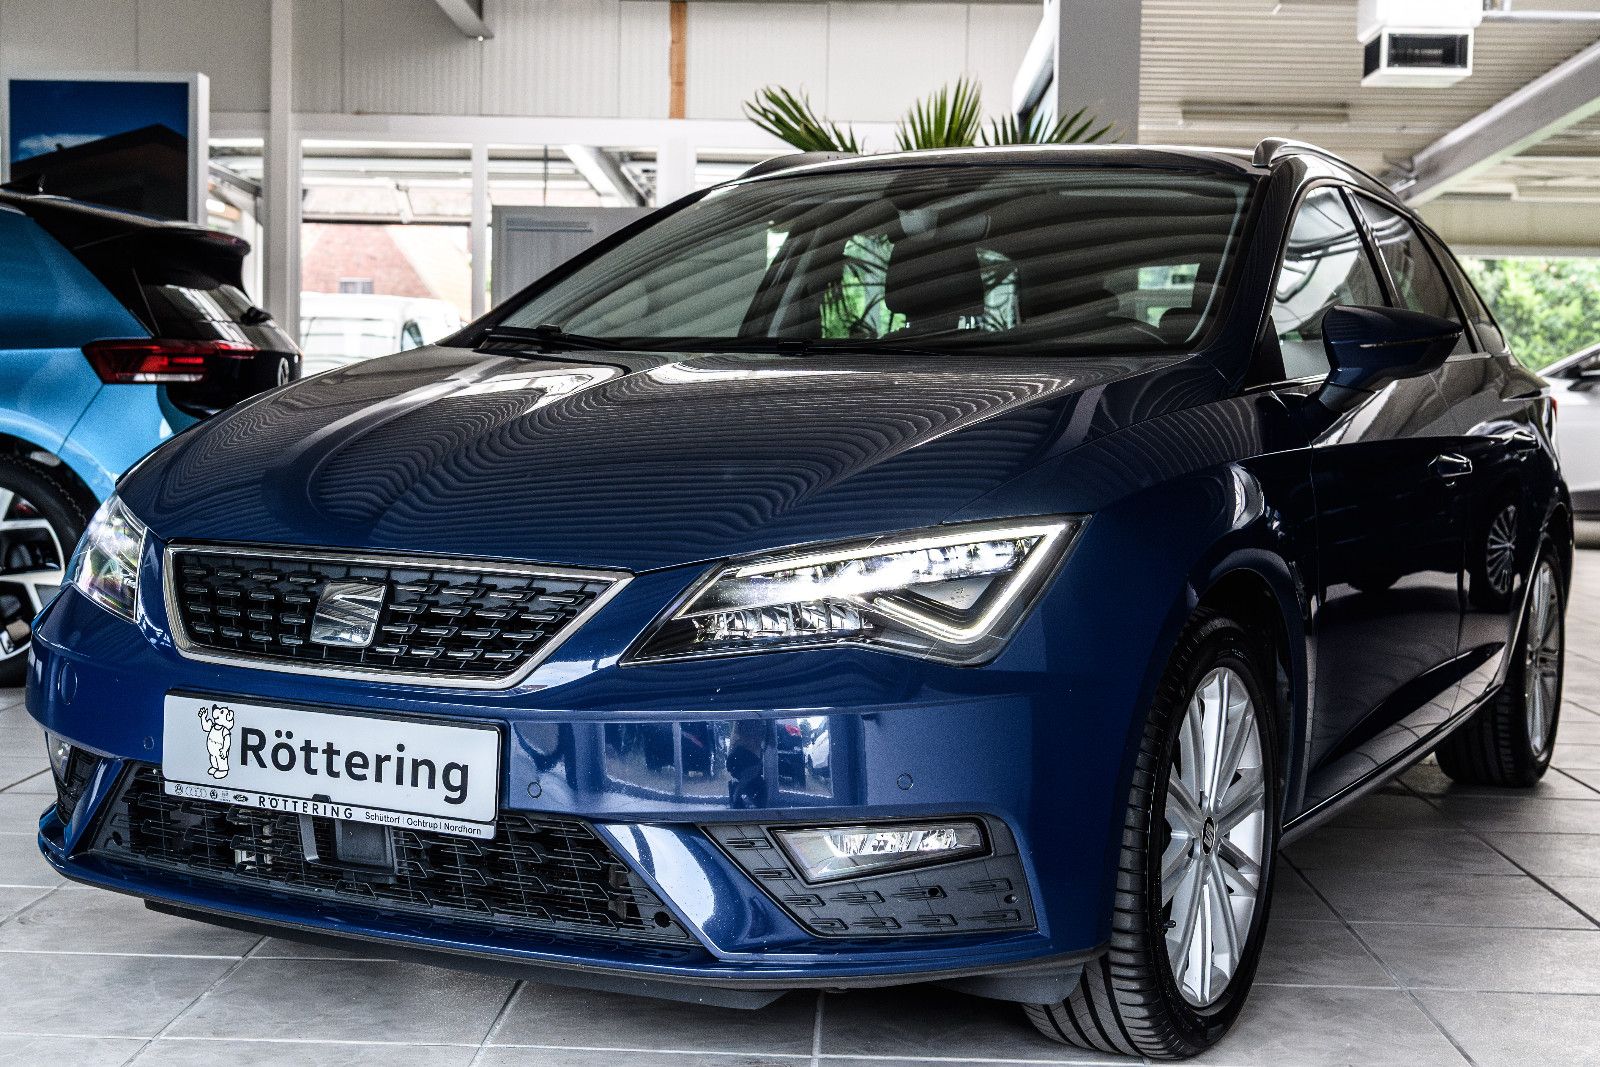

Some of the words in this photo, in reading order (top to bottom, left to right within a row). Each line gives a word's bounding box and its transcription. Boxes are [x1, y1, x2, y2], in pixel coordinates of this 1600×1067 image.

[240, 726, 469, 804] Röttering
[258, 797, 353, 819] RÖTTERING
[365, 811, 400, 824] Schüttorf
[406, 817, 438, 830] Ochtrup
[444, 822, 482, 835] Nordhorn
